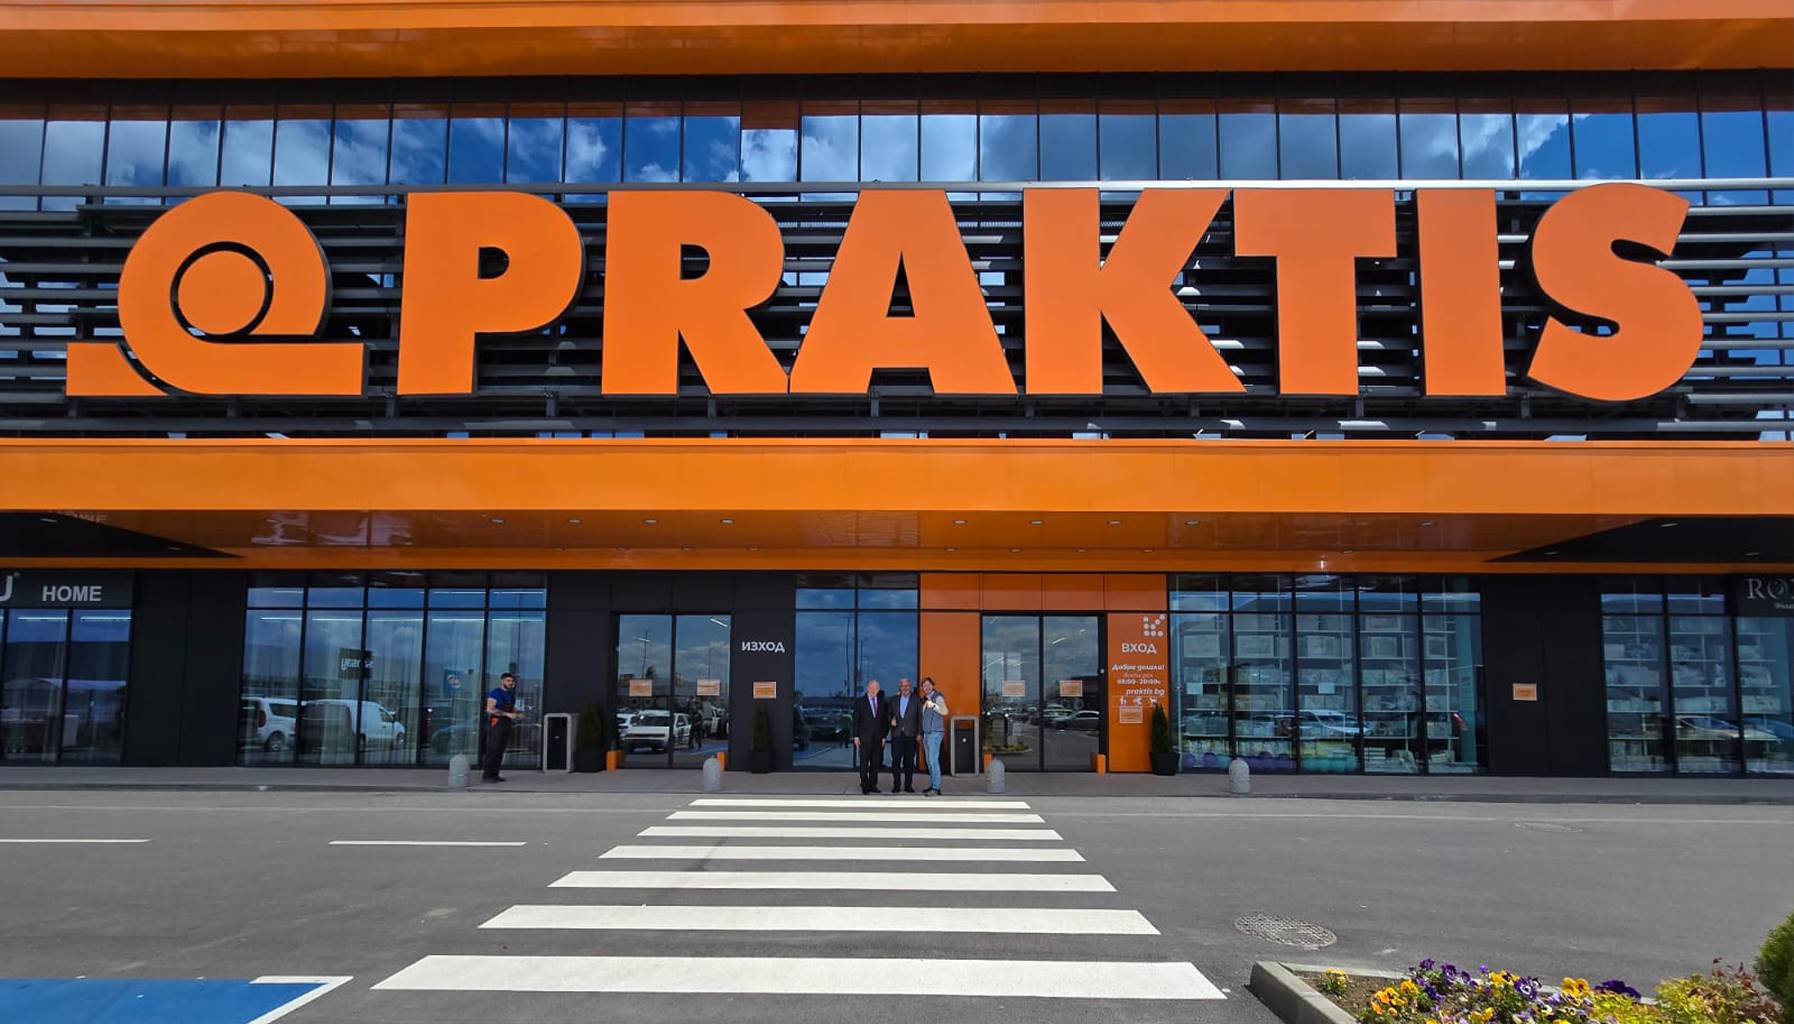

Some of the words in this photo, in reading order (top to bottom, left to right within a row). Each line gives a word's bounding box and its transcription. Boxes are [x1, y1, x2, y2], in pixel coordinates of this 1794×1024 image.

[397, 182, 1704, 400] PRAKTIS
[42, 585, 102, 601] HOME
[1746, 578, 1794, 600] RO
[741, 641, 786, 653] ИЗХОД
[1121, 643, 1157, 654] ВХОД
[1126, 688, 1165, 696] praktis.bg
